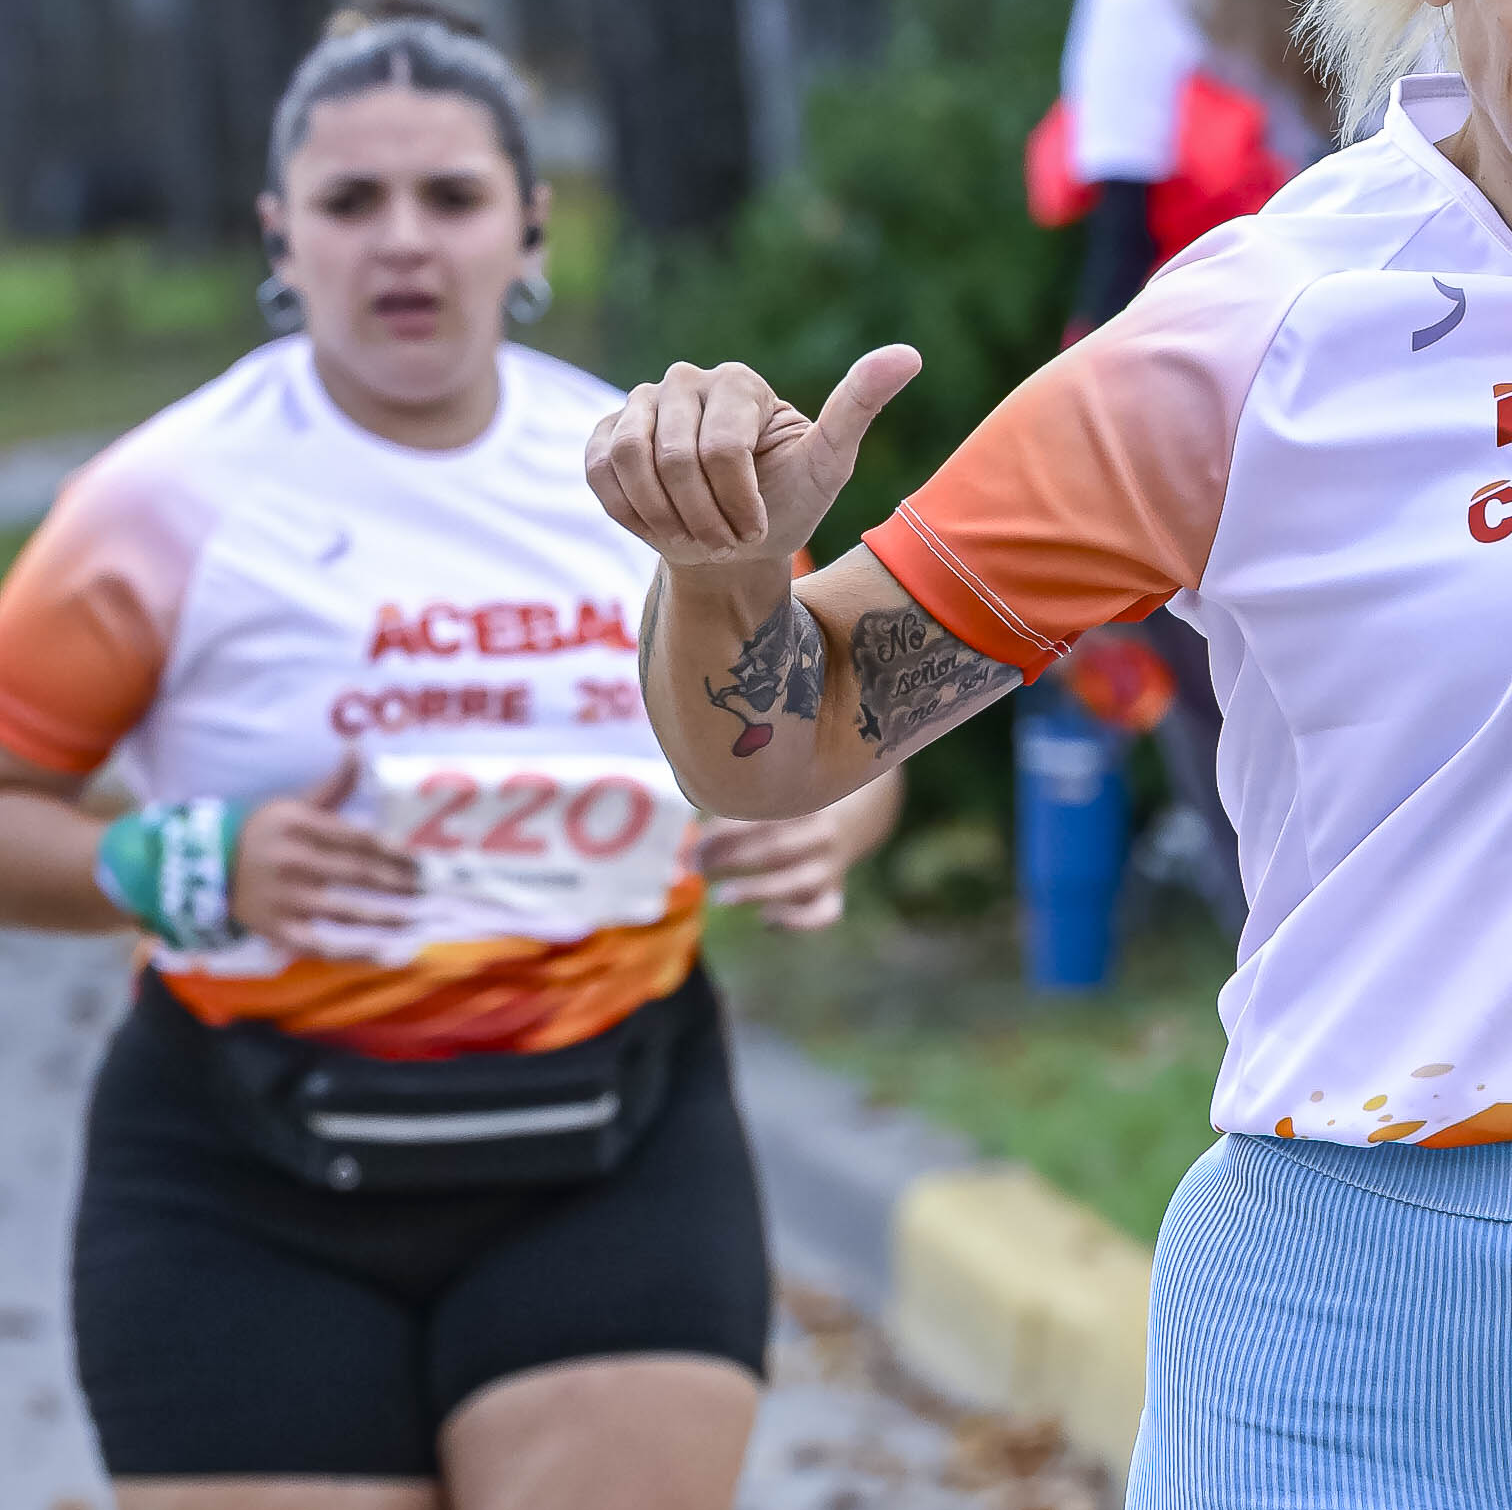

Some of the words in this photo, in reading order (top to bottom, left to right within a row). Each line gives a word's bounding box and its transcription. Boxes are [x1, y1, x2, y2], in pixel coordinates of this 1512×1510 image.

[878, 613, 926, 663] No
[890, 652, 959, 698] señor
[410, 772, 654, 857] 220
